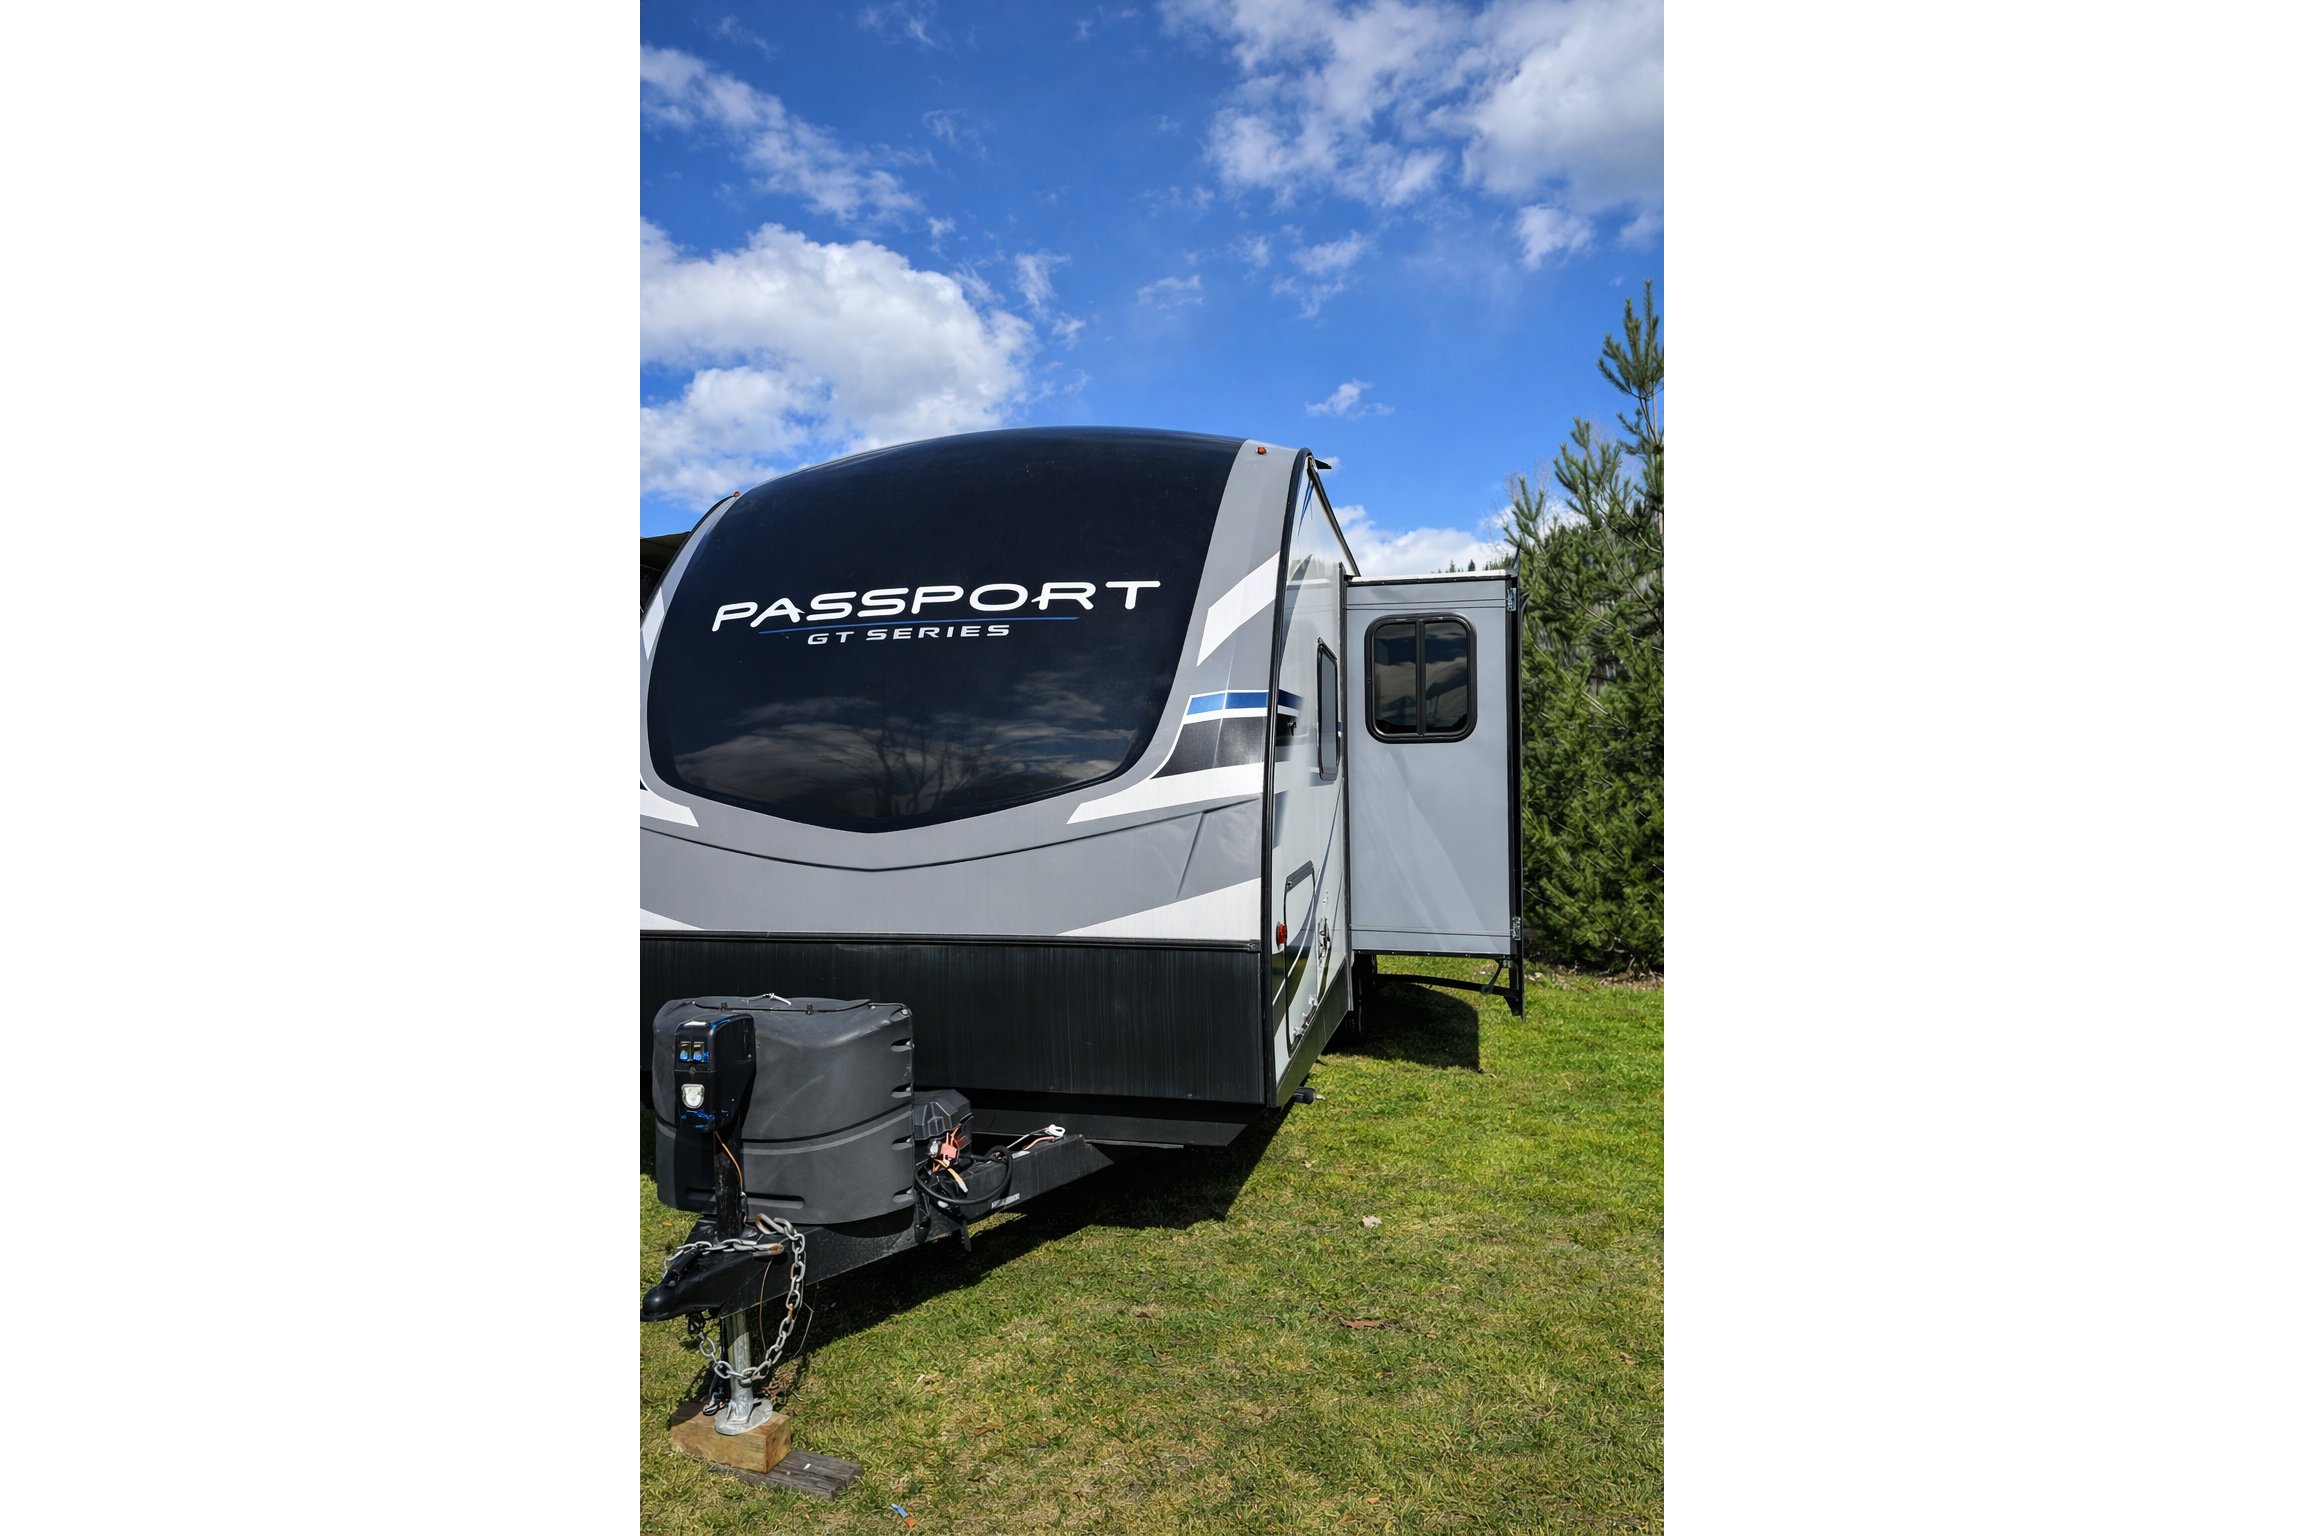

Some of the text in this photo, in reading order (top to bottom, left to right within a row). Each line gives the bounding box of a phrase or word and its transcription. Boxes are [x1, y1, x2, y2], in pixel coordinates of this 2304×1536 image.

[711, 580, 1161, 632] PASSPORT
[807, 624, 1010, 645] GT SERIES
